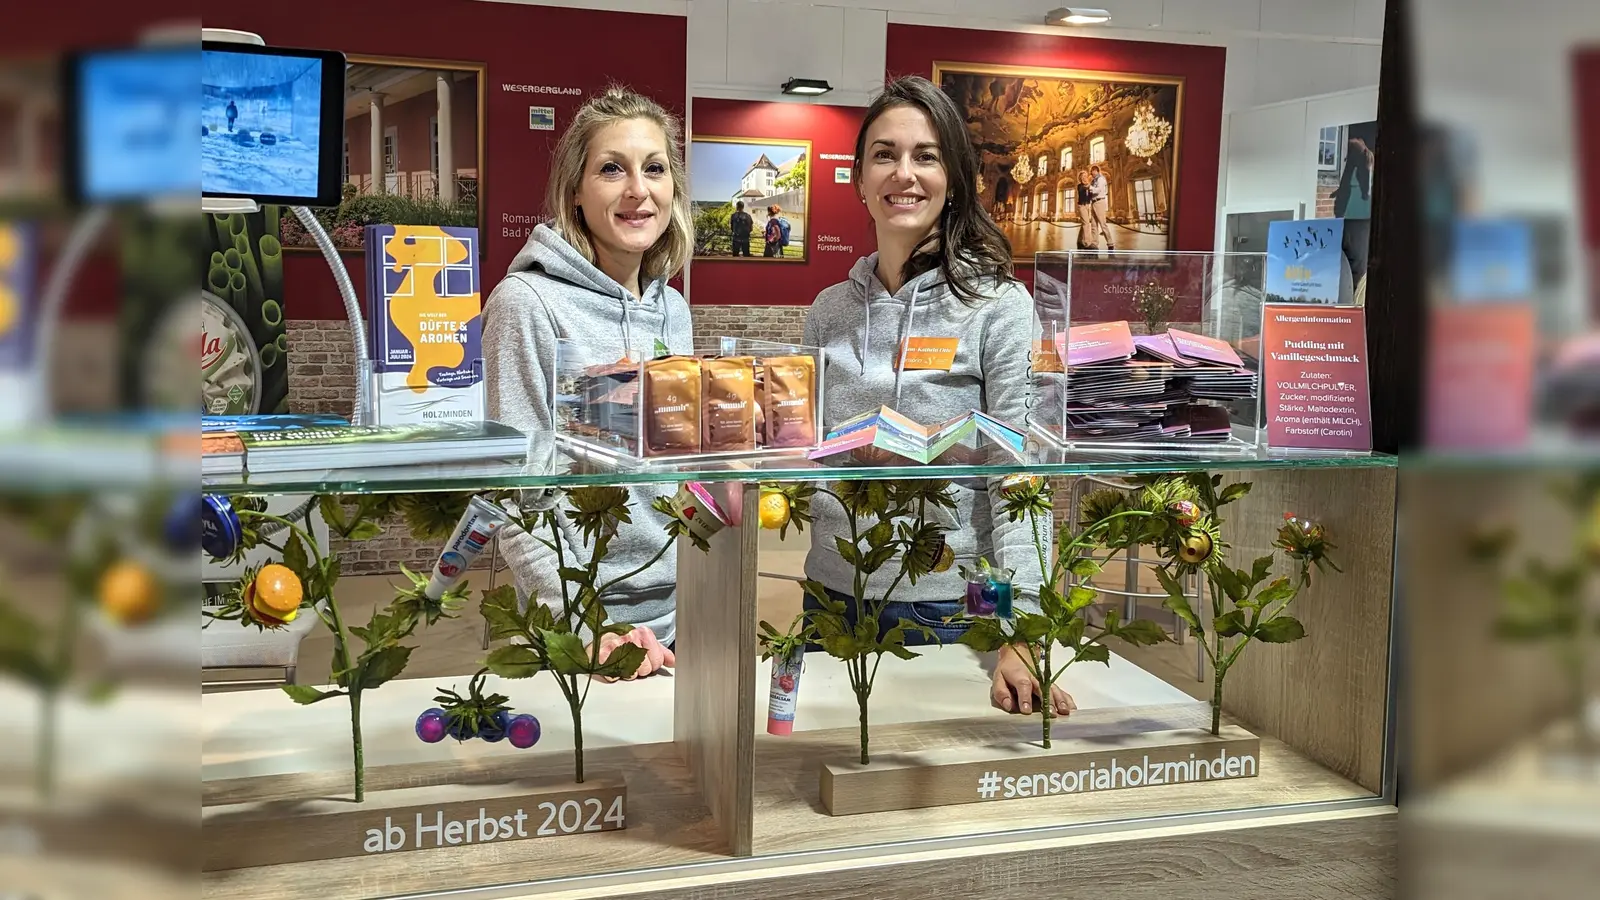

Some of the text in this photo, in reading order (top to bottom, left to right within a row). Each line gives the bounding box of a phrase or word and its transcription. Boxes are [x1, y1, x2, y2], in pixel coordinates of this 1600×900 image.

[502, 83, 582, 96] WESERBERGLAND
[502, 227, 521, 238] Bad
[817, 234, 841, 243] Schloss
[817, 243, 853, 253] Fürstenberg
[1103, 284, 1133, 294] Schloss
[1274, 315, 1352, 324] Allergeninformation
[419, 319, 468, 332] DÜFTE &
[420, 333, 468, 344] AROMEN
[1284, 340, 1345, 350] Pudding mit
[1270, 352, 1360, 363] Vanillegeschmack
[1300, 371, 1332, 379] Zutaten:
[1276, 382, 1357, 392] VOLLMILCHPULVER,
[667, 395, 677, 404] 4g
[1280, 392, 1355, 402] Zucker, modifizierte
[423, 409, 473, 419] HOLZMINDEN
[1279, 404, 1357, 414] Stärke, Maltodextrin,
[1275, 415, 1301, 423] Aroma
[1302, 416, 1331, 425] (enthält
[1285, 427, 1353, 437] Farbstoff (Carotin)
[452, 514, 479, 551] parodontax
[977, 748, 1256, 799] #sensoriaholzminden
[363, 795, 625, 853] ab Herbst 2024
